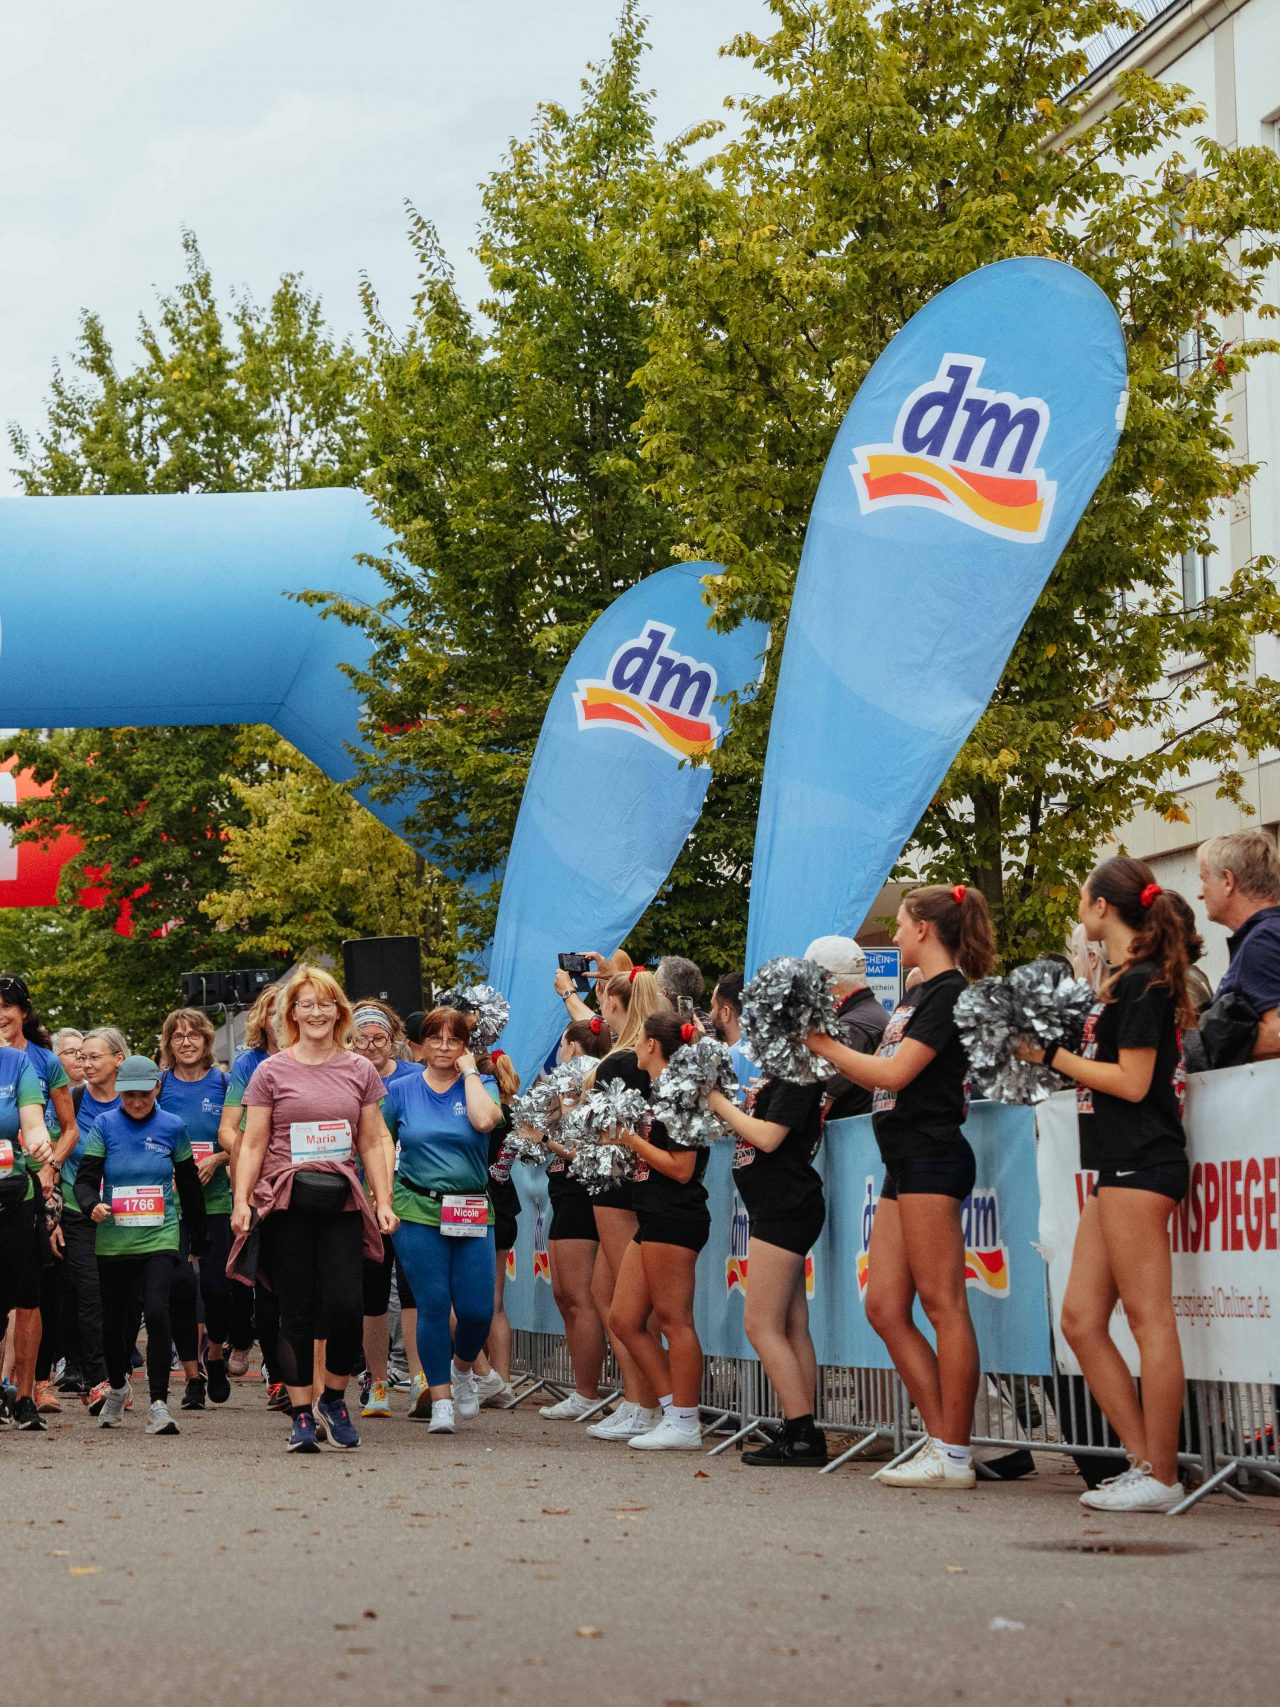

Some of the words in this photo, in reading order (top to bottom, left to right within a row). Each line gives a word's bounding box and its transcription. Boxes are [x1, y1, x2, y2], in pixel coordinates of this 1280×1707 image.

[901, 364, 1042, 474] dm
[611, 628, 712, 717] dm
[865, 955, 893, 964] CHEIN-
[306, 1134, 336, 1144] Maria
[123, 1199, 155, 1211] 1766
[453, 1207, 479, 1218] Nicole
[1173, 1285, 1271, 1327] enspiegelOnline.de
